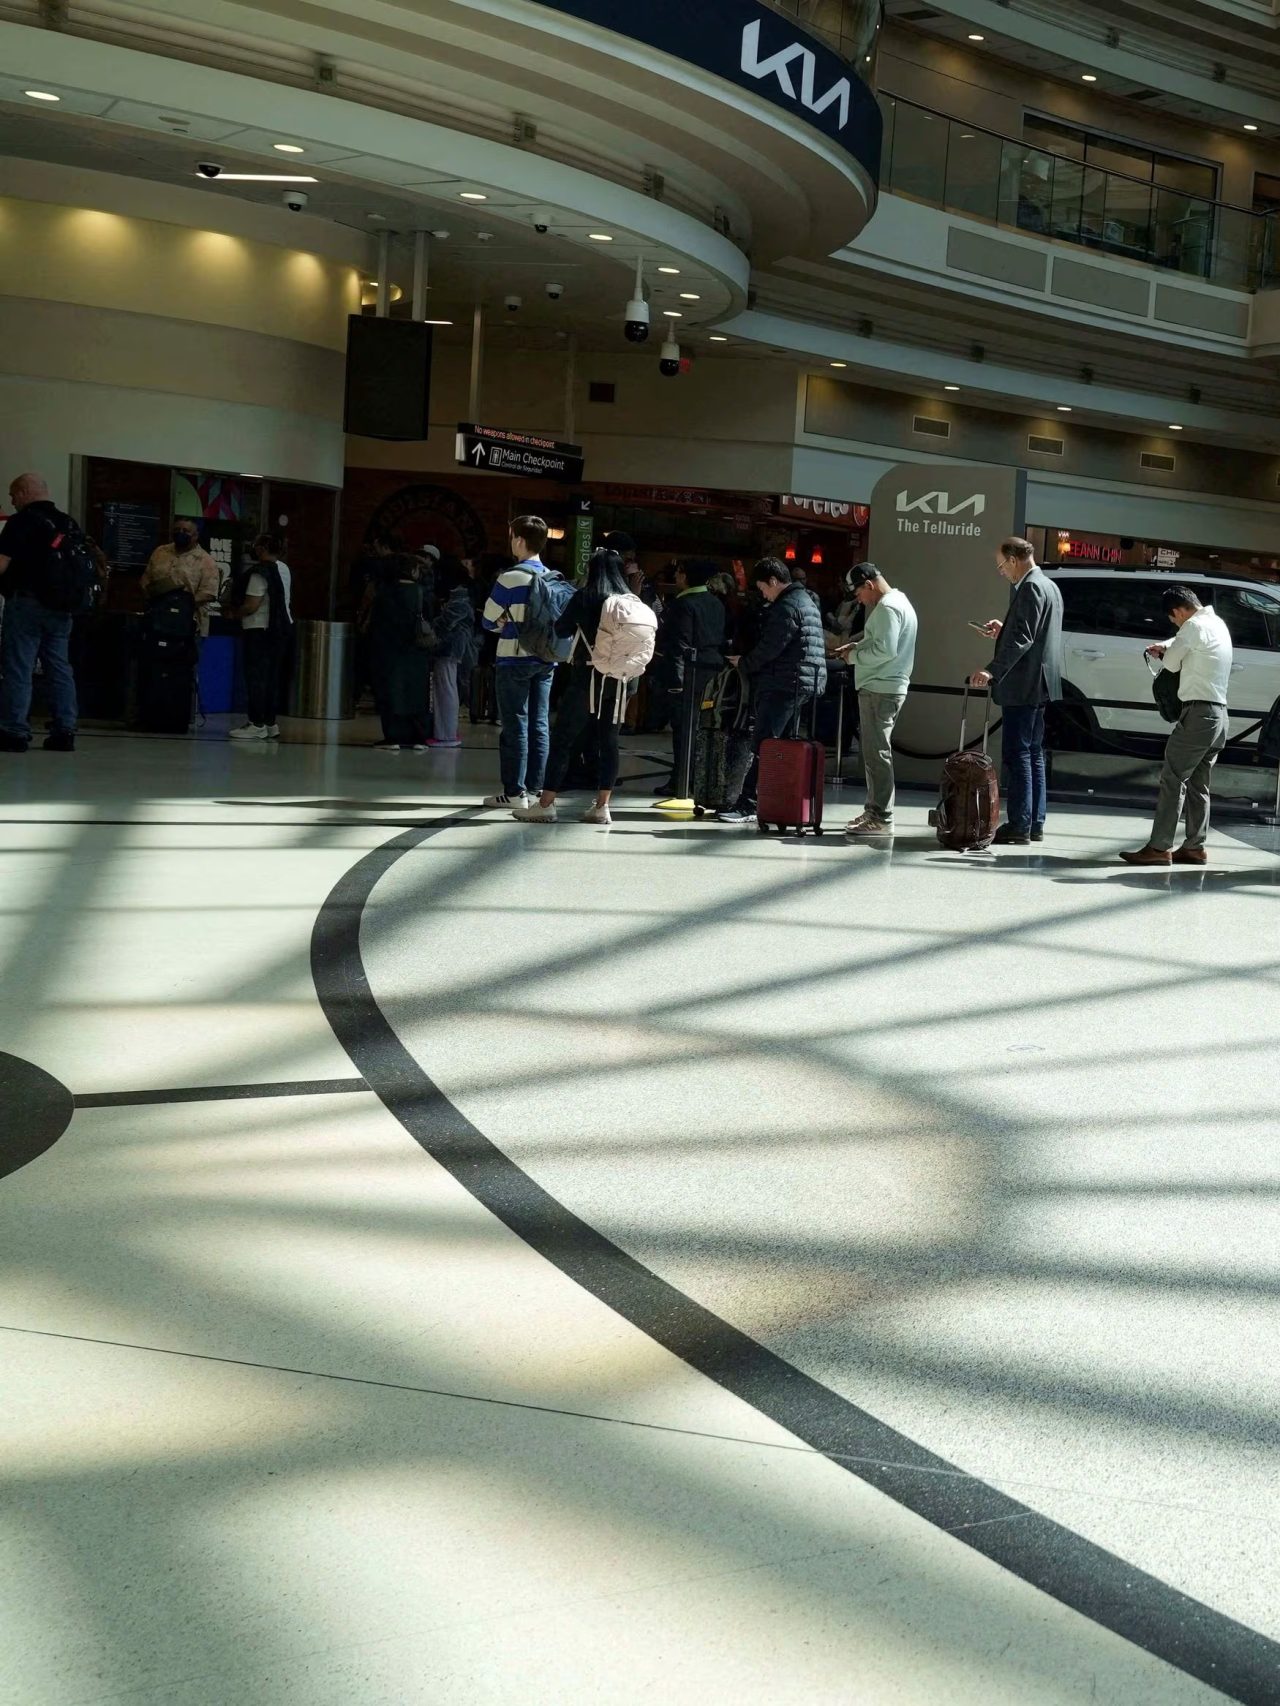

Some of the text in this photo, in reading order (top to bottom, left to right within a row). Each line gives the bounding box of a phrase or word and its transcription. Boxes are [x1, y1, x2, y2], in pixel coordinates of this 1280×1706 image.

[474, 425, 483, 435] No
[482, 428, 506, 440] weapons
[506, 431, 525, 443] allowed
[530, 437, 555, 450] checkpoint
[502, 448, 565, 471] Main Checkpoint
[895, 489, 986, 517] KIA
[896, 518, 981, 537] The Telluride
[576, 533, 591, 575] Gates
